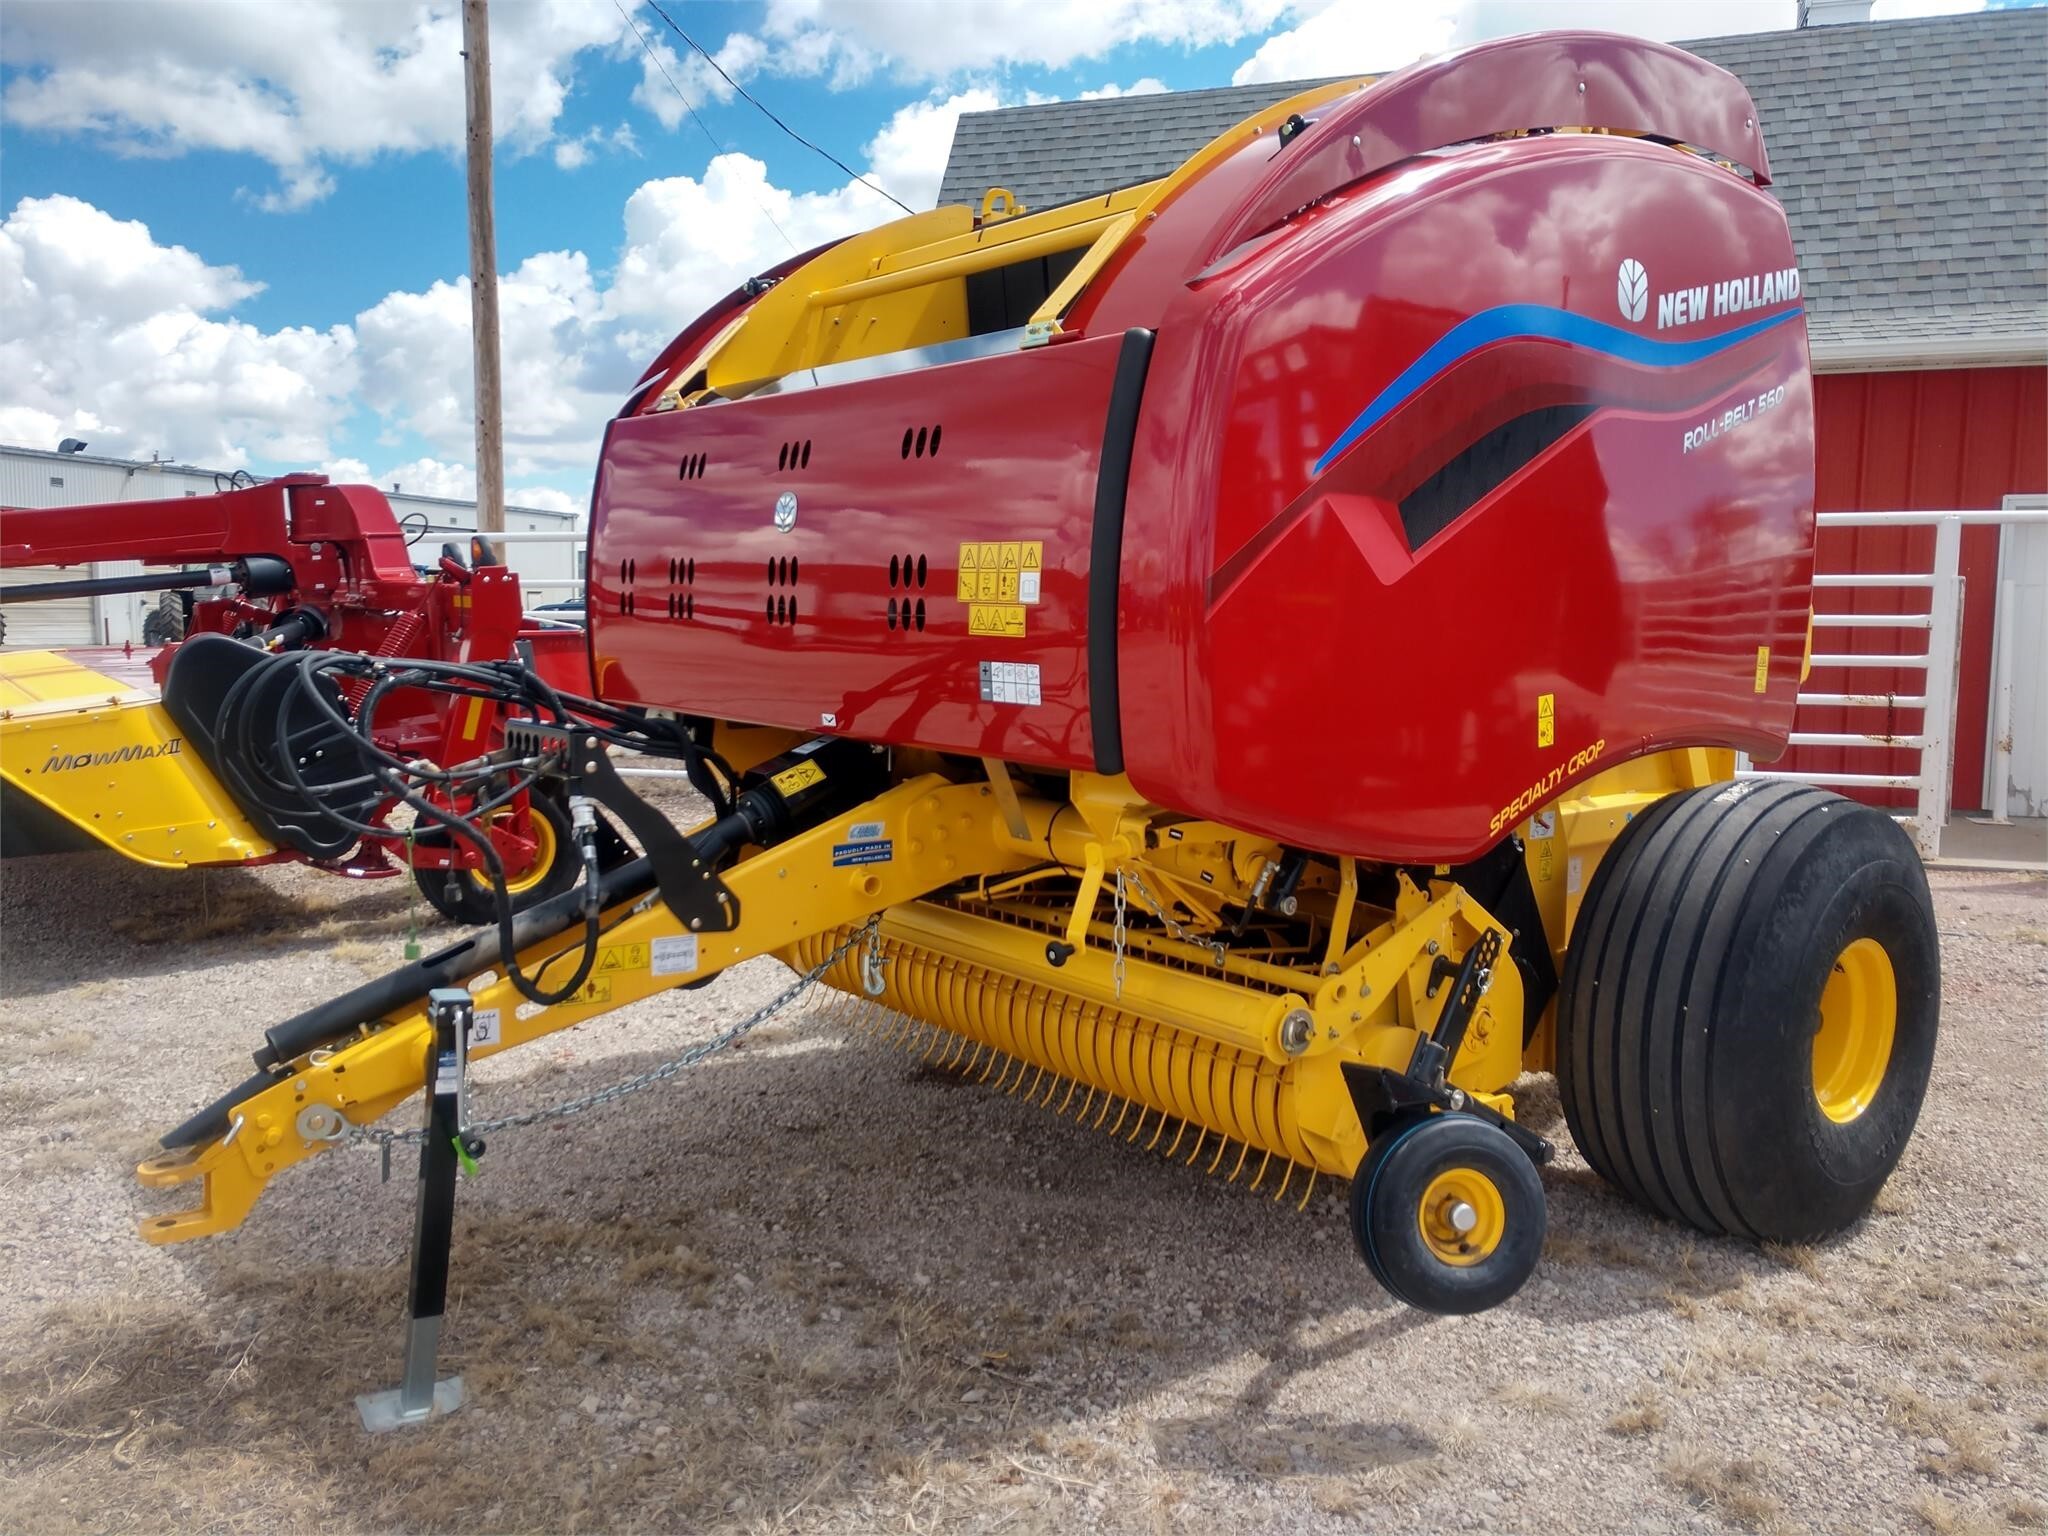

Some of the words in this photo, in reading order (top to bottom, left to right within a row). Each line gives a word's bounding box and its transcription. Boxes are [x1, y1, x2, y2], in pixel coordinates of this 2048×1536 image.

[1657, 285, 1709, 330] NEW
[1713, 267, 1800, 318] HOLLAND
[1683, 398, 1756, 454] ROLL-BELT
[1757, 385, 1785, 415] 560
[1489, 762, 1566, 838] SPECIALTY
[1567, 738, 1606, 777] CROP
